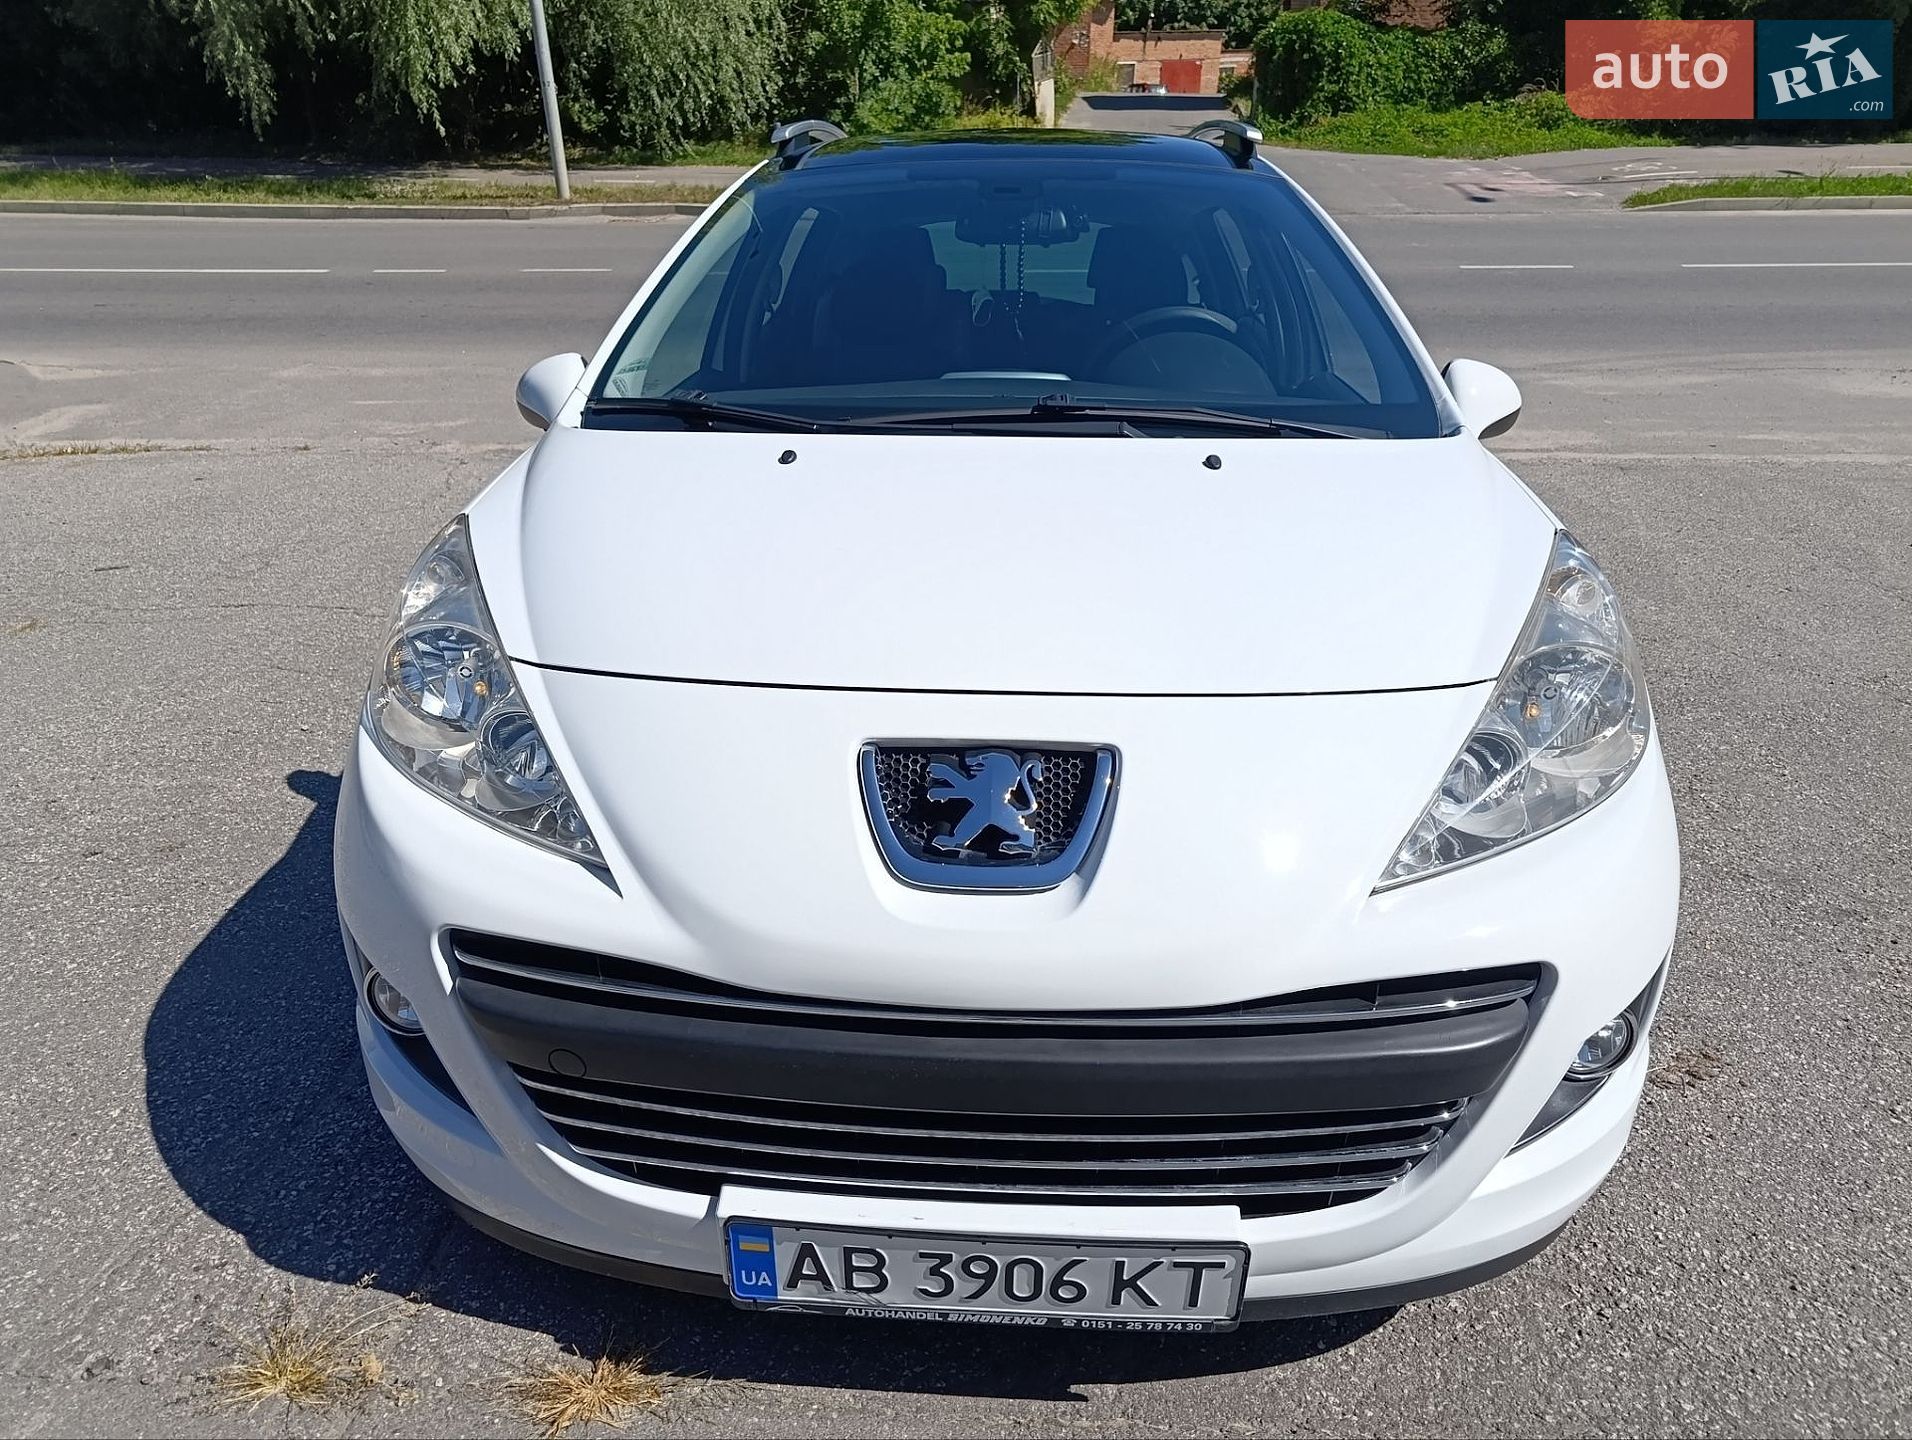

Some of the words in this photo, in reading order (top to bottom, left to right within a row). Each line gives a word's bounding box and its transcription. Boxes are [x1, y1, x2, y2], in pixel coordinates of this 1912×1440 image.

[741, 1269, 773, 1287] UA
[784, 1242, 889, 1295] AB
[917, 1251, 1089, 1300] 3906
[1110, 1259, 1226, 1308] KT
[845, 1308, 943, 1321] AUTOHANDEL
[947, 1313, 1048, 1326] SIMONENKO
[1081, 1319, 1113, 1329] 0151
[1126, 1321, 1142, 1330] 25
[1146, 1322, 1162, 1331] 78
[1166, 1322, 1182, 1331] 74
[1186, 1323, 1202, 1331] 30
